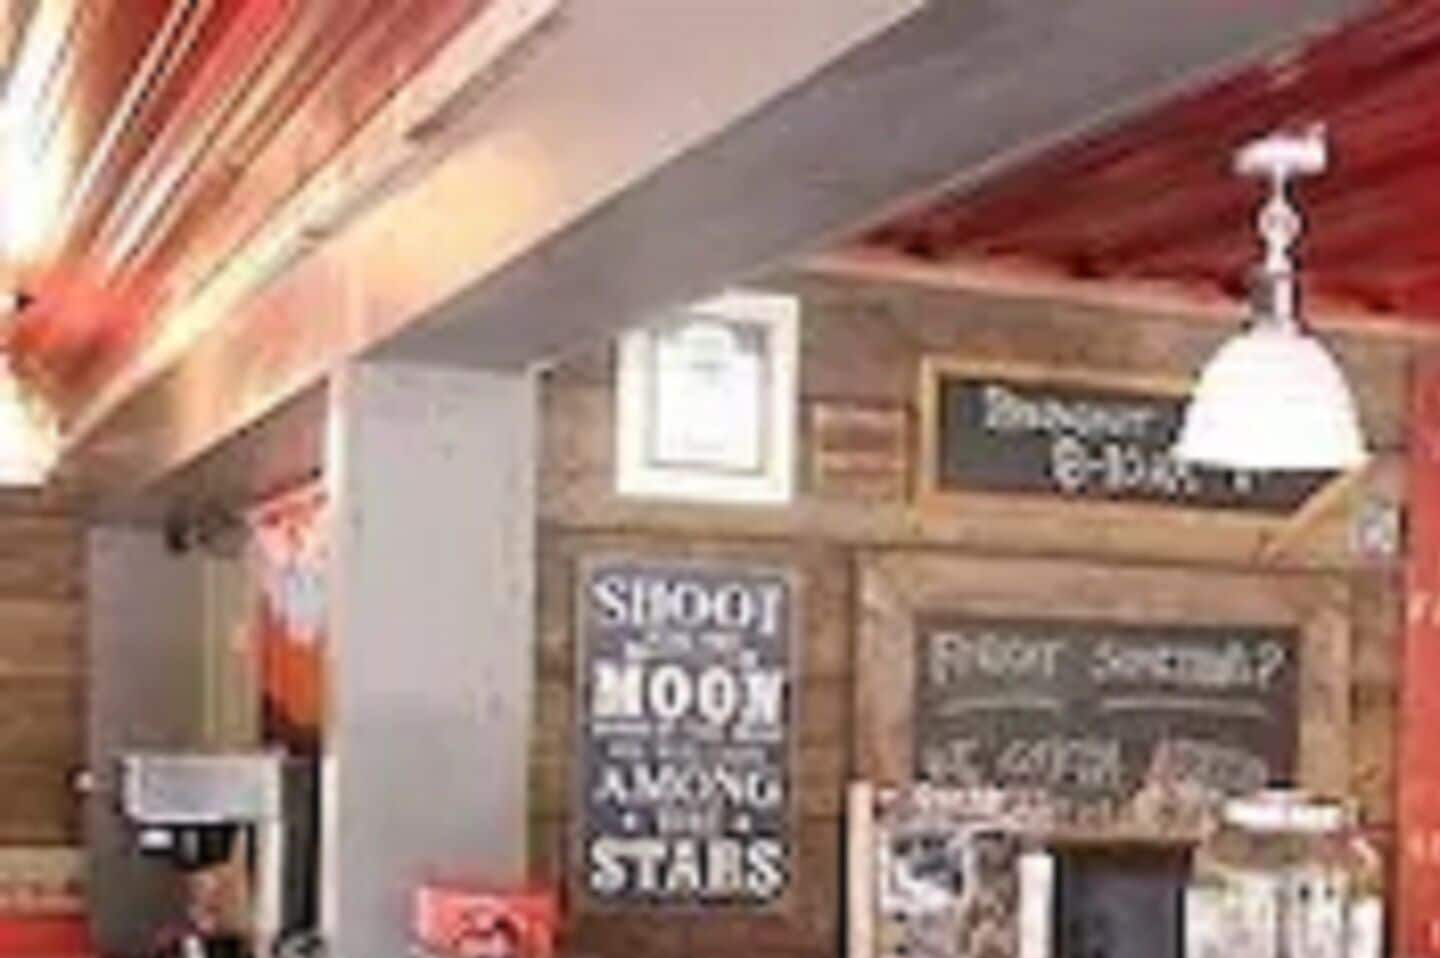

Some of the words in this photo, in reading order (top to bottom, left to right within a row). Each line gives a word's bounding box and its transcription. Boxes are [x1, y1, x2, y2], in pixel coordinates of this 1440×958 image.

[592, 575, 784, 636] SHOOT
[592, 658, 785, 724] MOON
[593, 761, 783, 810] AMONG
[591, 837, 784, 897] STARS
